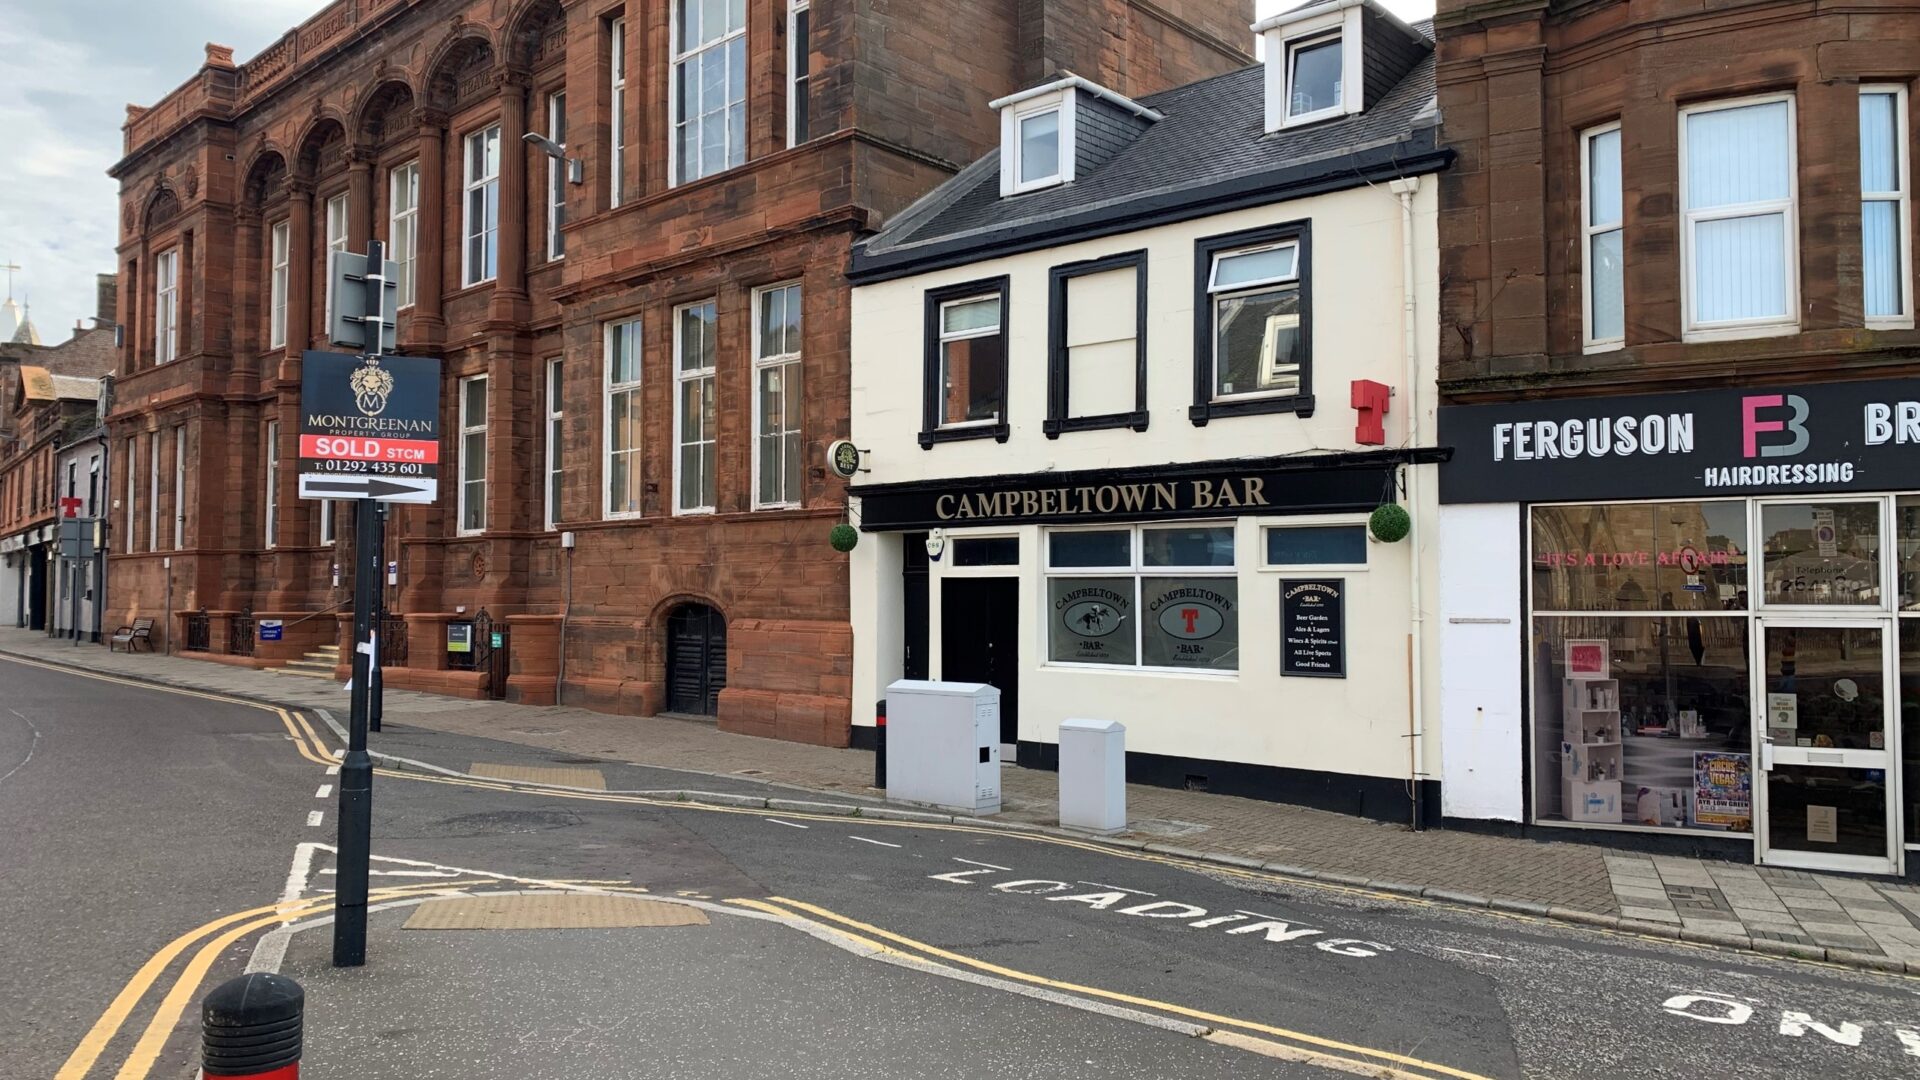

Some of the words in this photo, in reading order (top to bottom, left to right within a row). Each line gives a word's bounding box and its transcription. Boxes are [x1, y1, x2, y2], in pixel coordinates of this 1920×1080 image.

[308, 414, 432, 432] MONTGREENAN
[1864, 401, 1920, 446] BR
[329, 429, 376, 437] PROPERTY
[381, 431, 411, 439] GROUP
[1493, 413, 1694, 461] FERGUSON
[316, 437, 380, 458] SOLD
[387, 448, 425, 460] STCM
[314, 462, 324, 471] T:
[325, 459, 368, 472] 01292
[371, 462, 396, 474] 435
[400, 462, 424, 475] 601
[1704, 462, 1854, 487] HAIRDRESSING
[936, 482, 1178, 520] CAMPBELTOWN
[1191, 476, 1270, 509] BAR
[1584, 552, 1597, 566] A
[1602, 552, 1649, 566] LOVE
[1055, 588, 1130, 610] CAMPBELTOWN
[1150, 588, 1233, 611] CAMPBELTOWN
[1285, 584, 1339, 599] CAMPBELTOWN
[1083, 641, 1102, 650] BAR
[1180, 644, 1201, 653] BAR
[1710, 760, 1737, 773] CIRCUS
[1710, 772, 1737, 786] VEGAS
[928, 868, 1396, 957] LOADING
